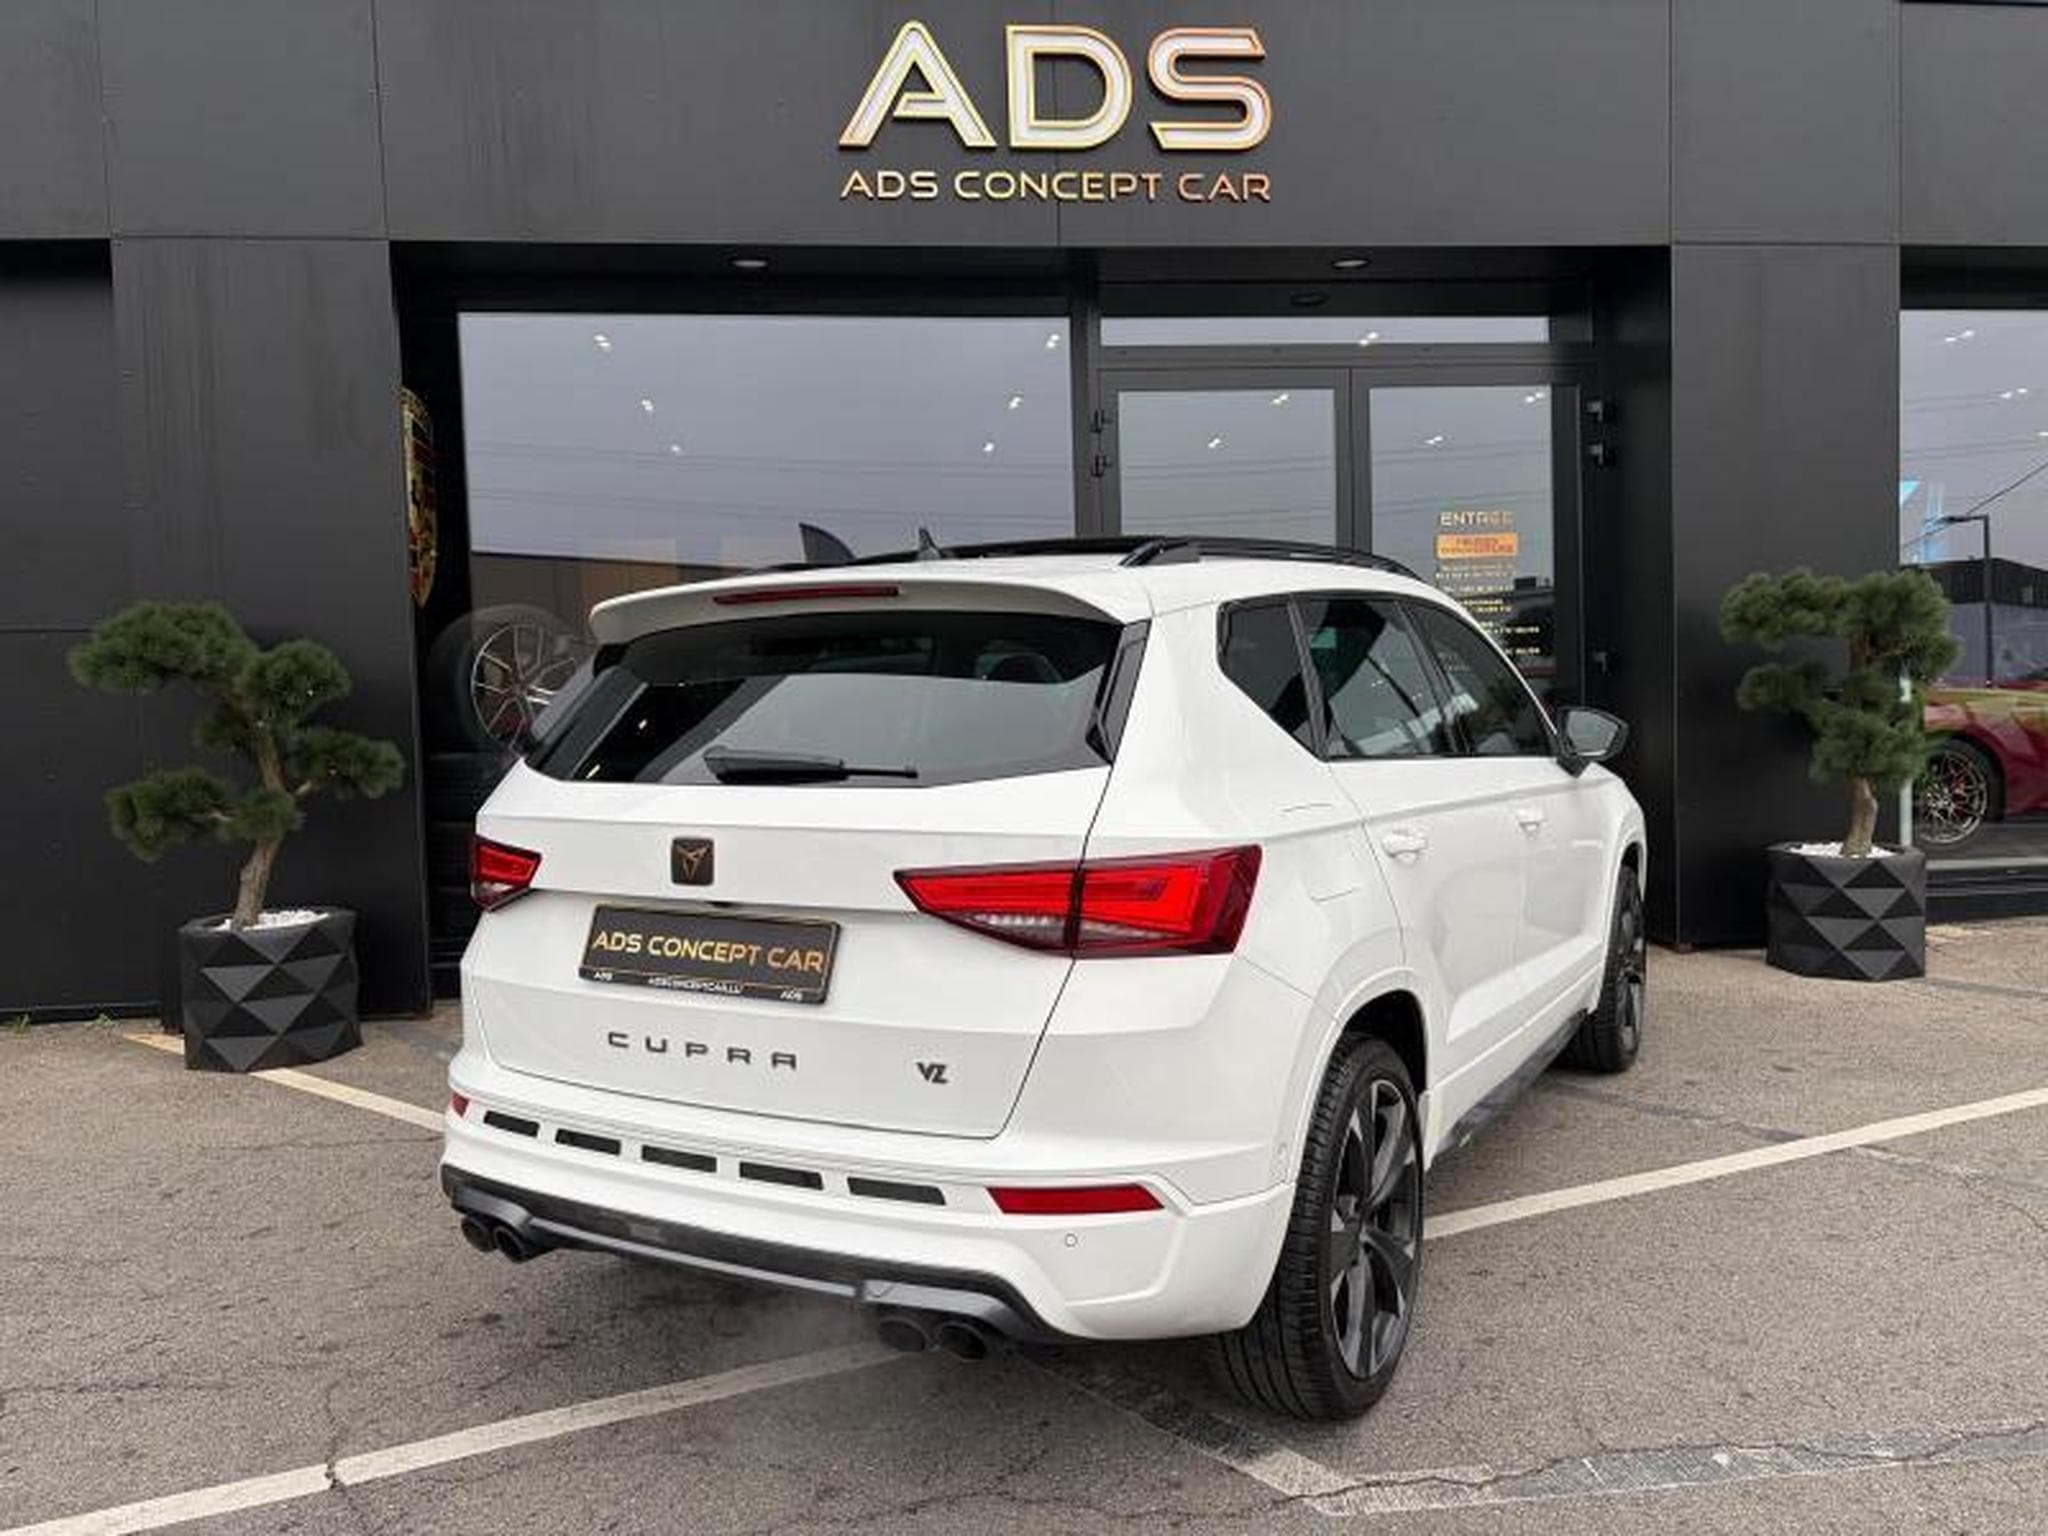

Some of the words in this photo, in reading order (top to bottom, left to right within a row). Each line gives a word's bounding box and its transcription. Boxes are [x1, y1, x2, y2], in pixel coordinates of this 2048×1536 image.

[839, 20, 1272, 151] ADS
[841, 171, 939, 199] ADS
[954, 172, 1162, 201] CONCEPT
[1178, 173, 1272, 201] CAR
[593, 931, 642, 954] ADS
[648, 936, 762, 966] CONCEPT
[767, 948, 823, 973] CAR
[607, 1031, 797, 1070] CUPRA
[916, 1061, 948, 1085] VZ
